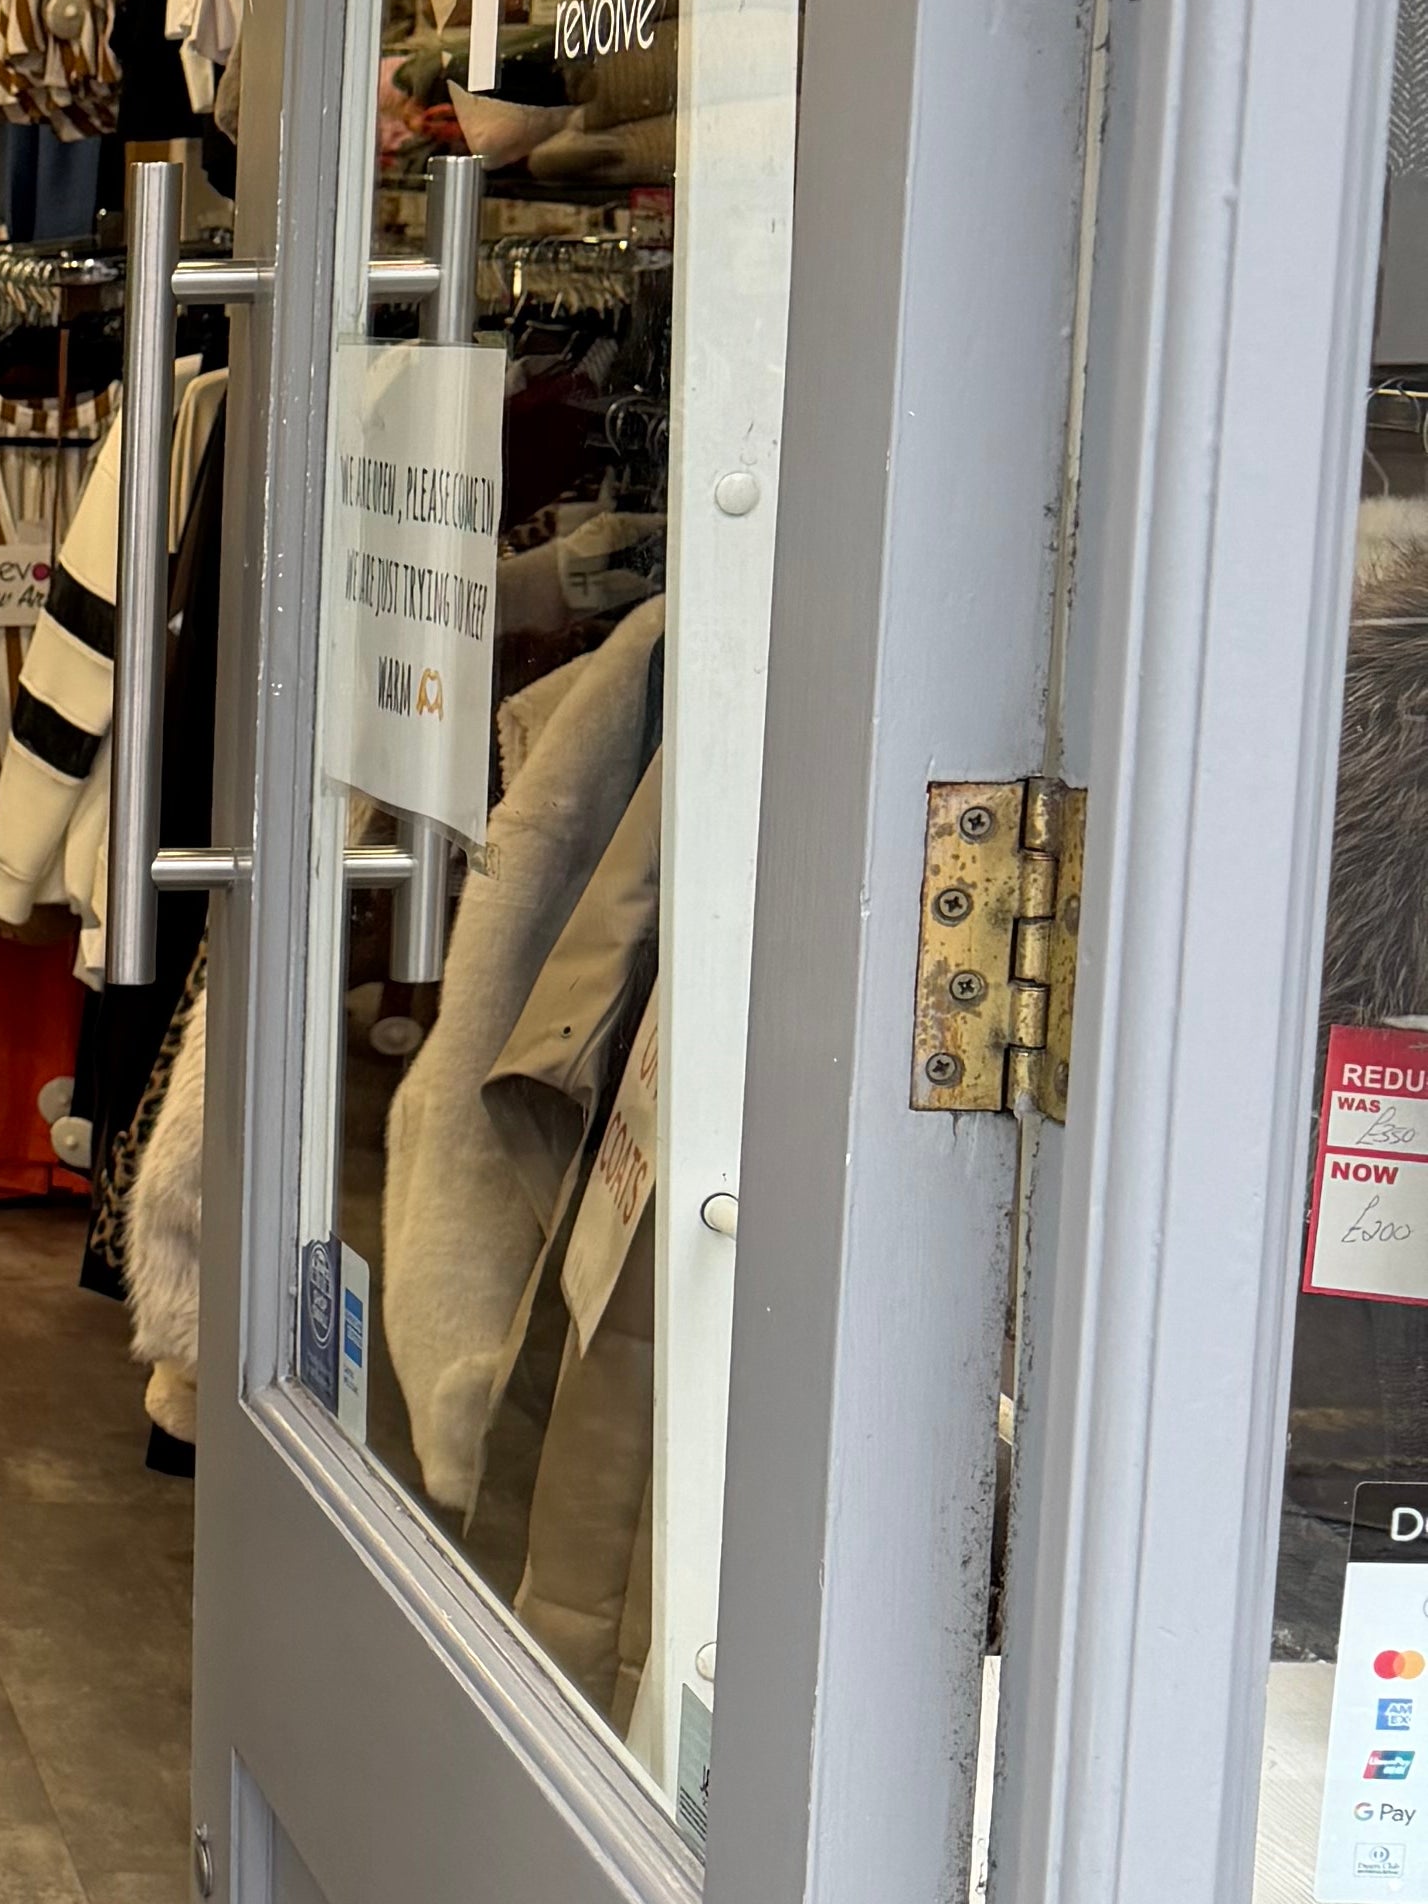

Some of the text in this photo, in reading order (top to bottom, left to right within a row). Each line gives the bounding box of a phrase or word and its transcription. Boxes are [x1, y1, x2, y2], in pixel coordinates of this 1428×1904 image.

[340, 454, 354, 507] WE
[373, 460, 396, 517] OPEN
[406, 466, 450, 526] PLEASE
[452, 473, 478, 533] COME
[345, 548, 487, 642] WE ARE JUST TRYING TO KEEP
[377, 655, 412, 717] WARM
[1342, 1063, 1428, 1092] REDU
[1338, 1096, 1381, 1114] WAS
[600, 1111, 648, 1225] COATS
[1331, 1161, 1398, 1185] NOW
[1391, 1507, 1428, 1542] D
[1380, 1803, 1417, 1826] Pay
